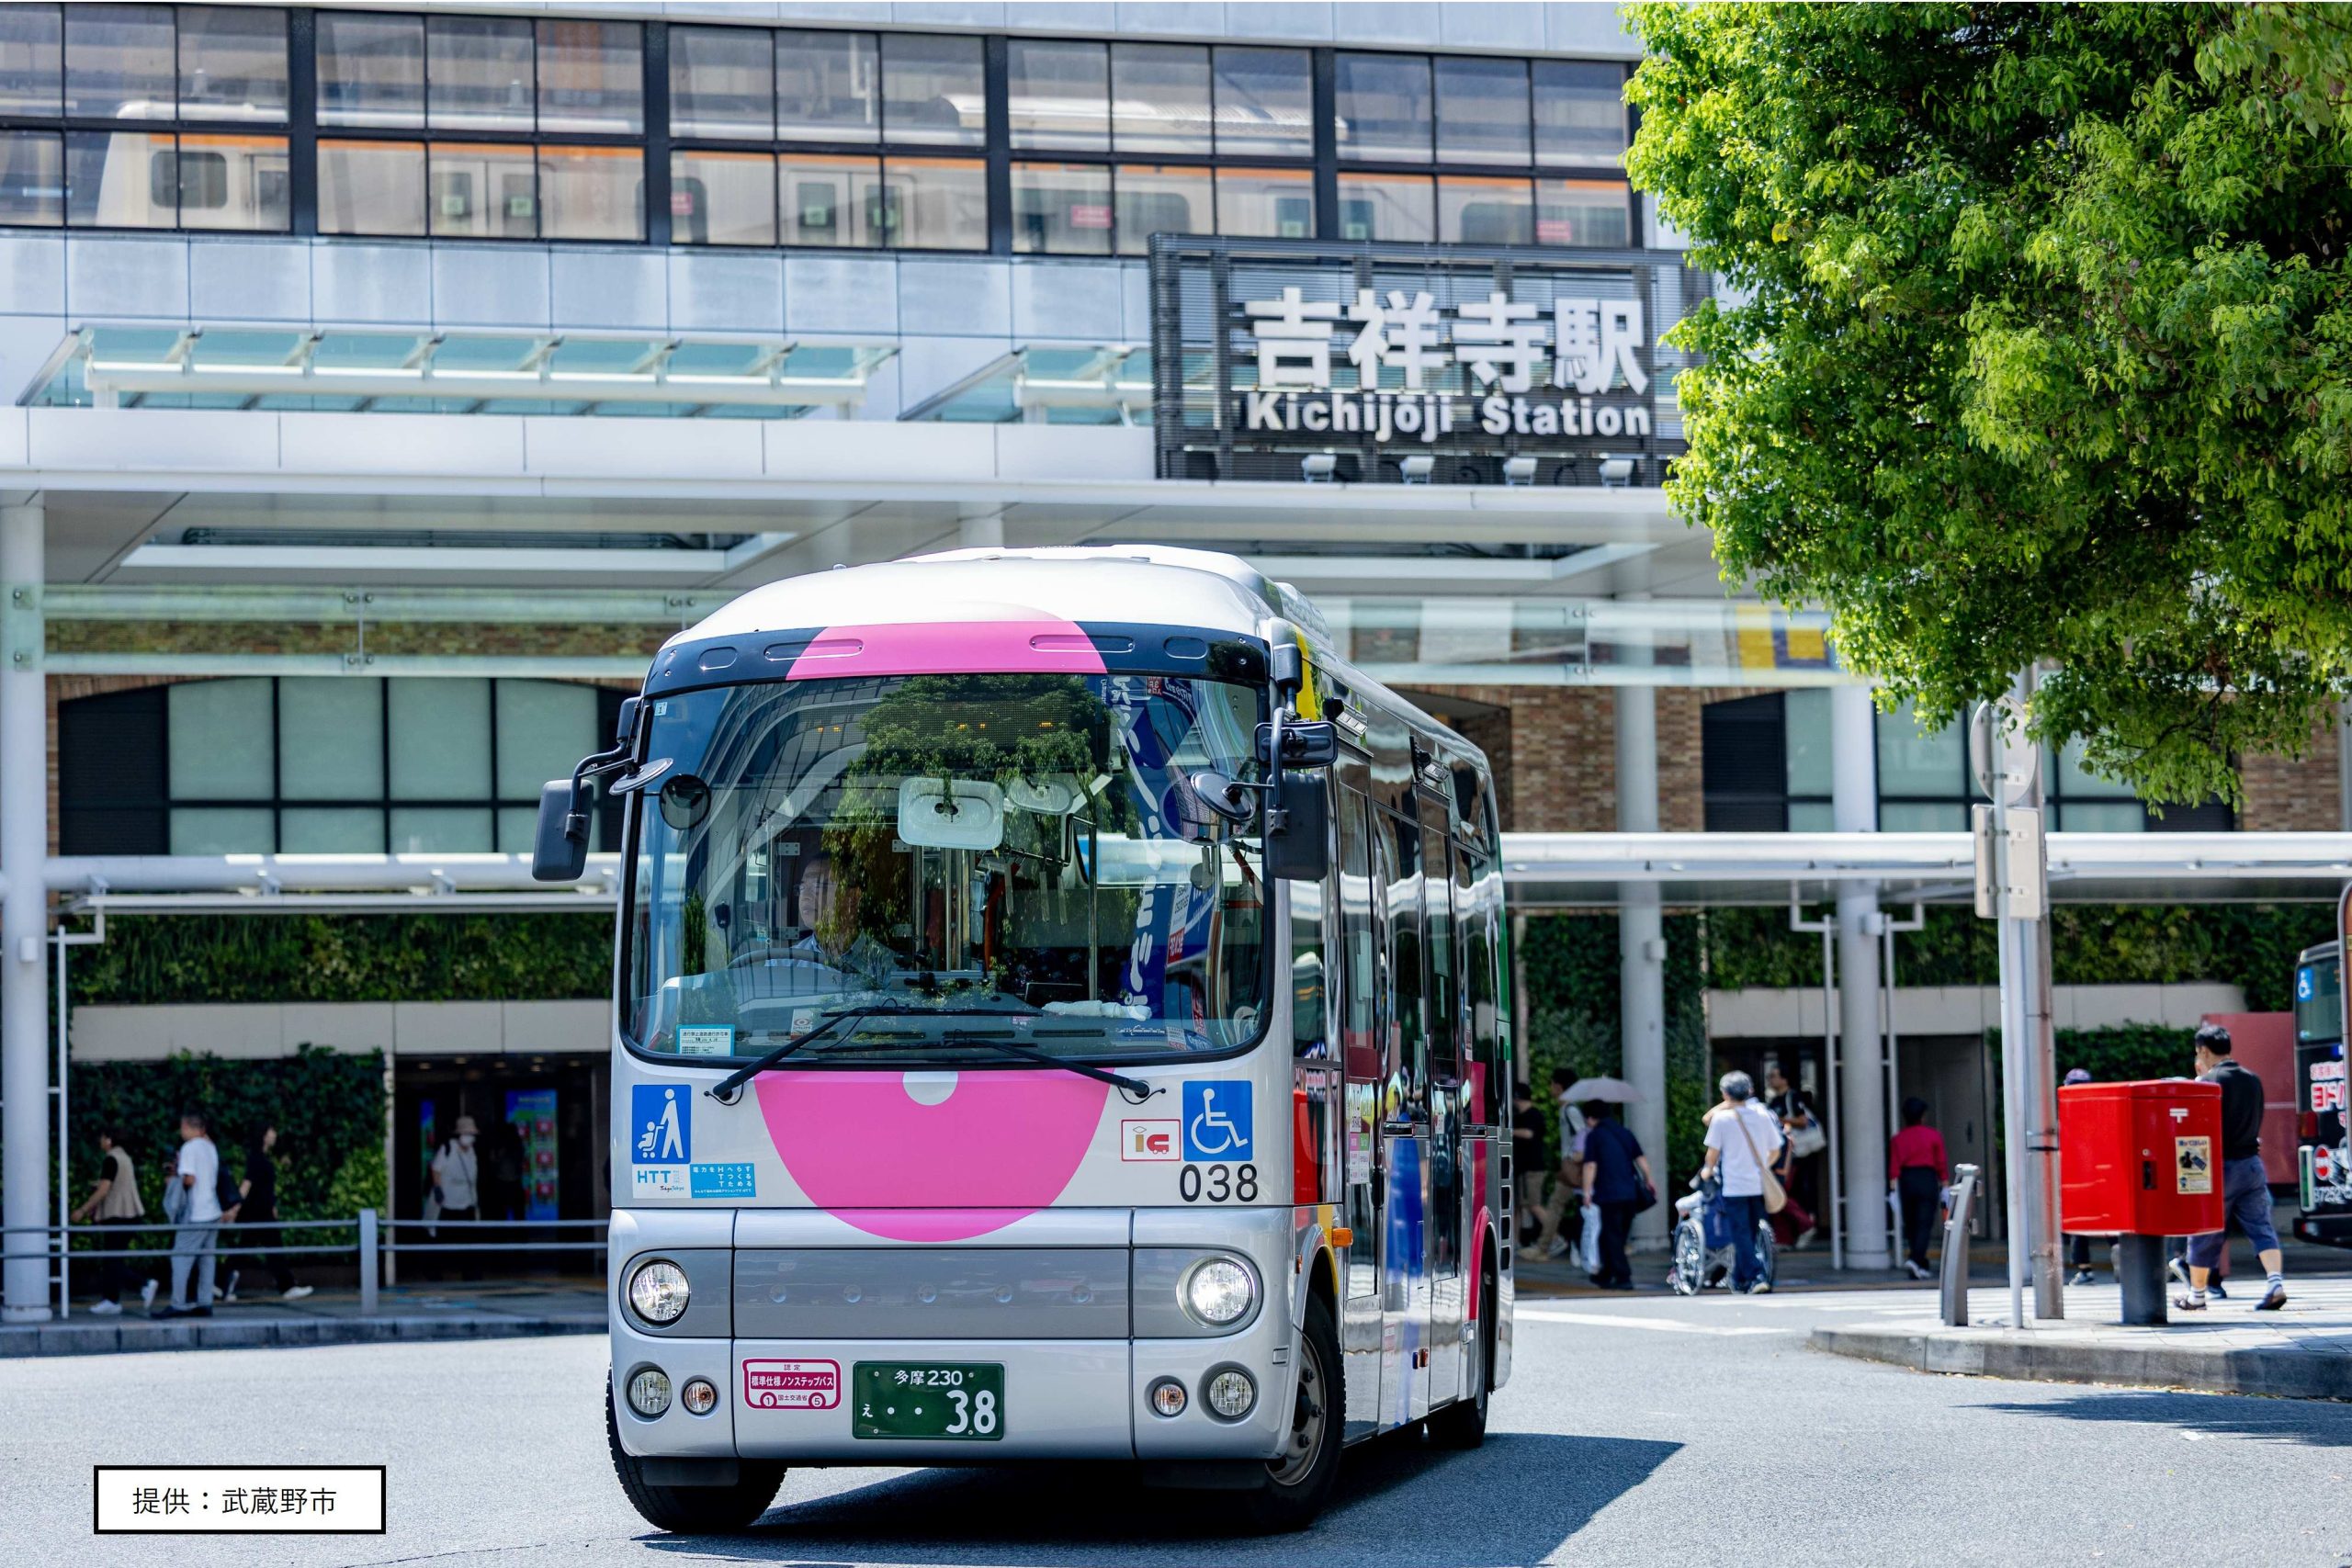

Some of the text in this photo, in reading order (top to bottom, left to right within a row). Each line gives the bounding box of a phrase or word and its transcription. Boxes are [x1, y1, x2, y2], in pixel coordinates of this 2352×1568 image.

[1245, 286, 1649, 395] 吉祥寺駅
[1247, 390, 1651, 443] Kichijōji Station
[637, 1170, 672, 1183] HTT
[1180, 1164, 1259, 1202] 038
[751, 1375, 833, 1387] 標準仕様ノンステップバス
[862, 1404, 873, 1417] え
[945, 1389, 996, 1434] 38
